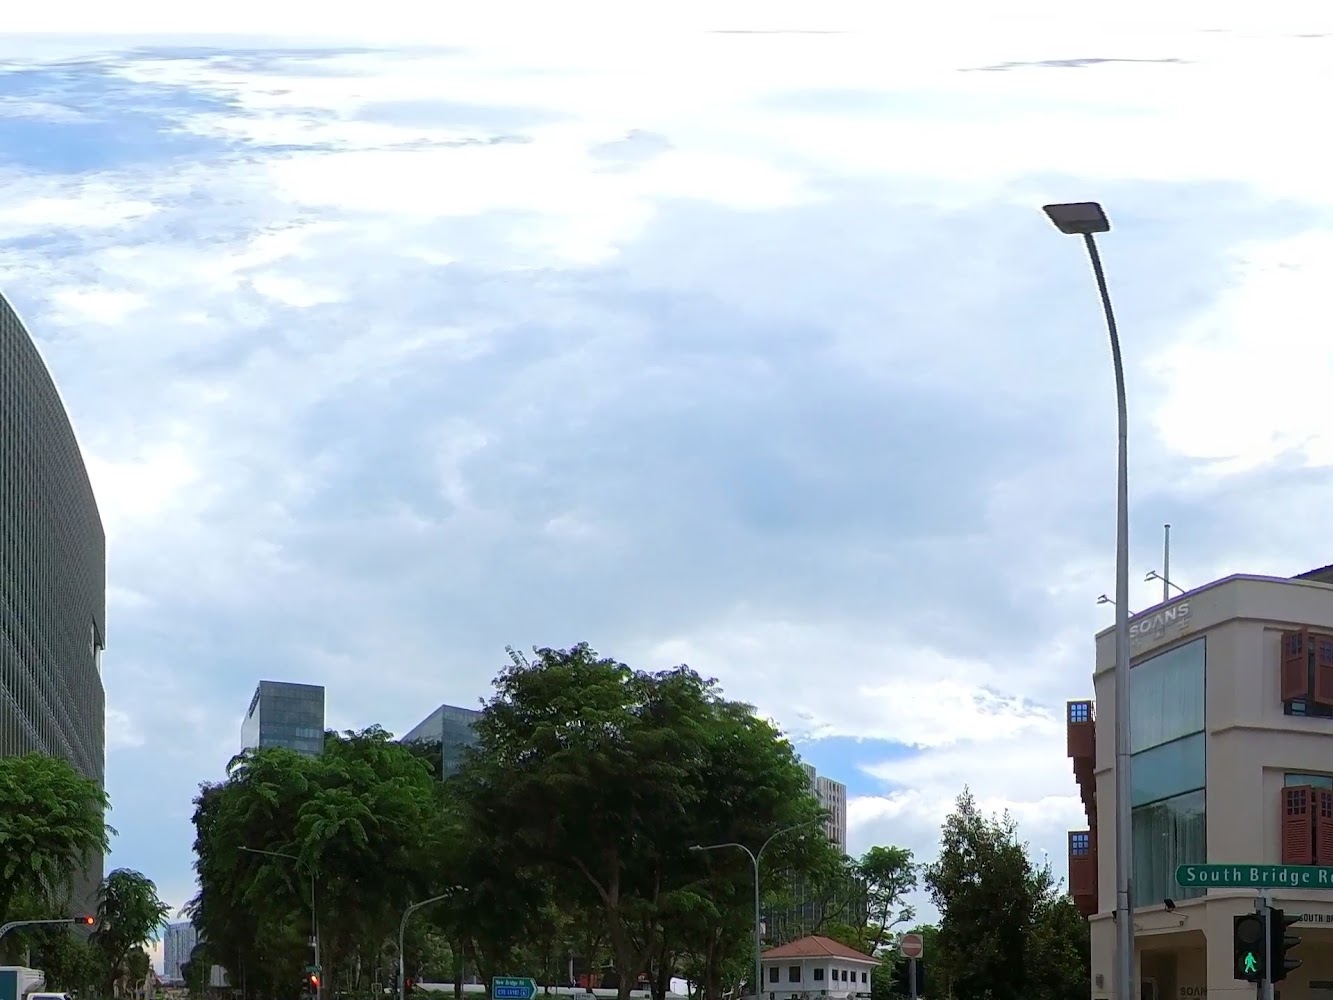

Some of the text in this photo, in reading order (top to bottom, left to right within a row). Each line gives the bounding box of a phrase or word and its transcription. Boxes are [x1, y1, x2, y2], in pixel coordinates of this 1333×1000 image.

[1129, 603, 1189, 638] SOANS
[1187, 867, 1242, 882] South
[1250, 867, 1310, 886] Bridge
[1299, 913, 1323, 922] SOUTH
